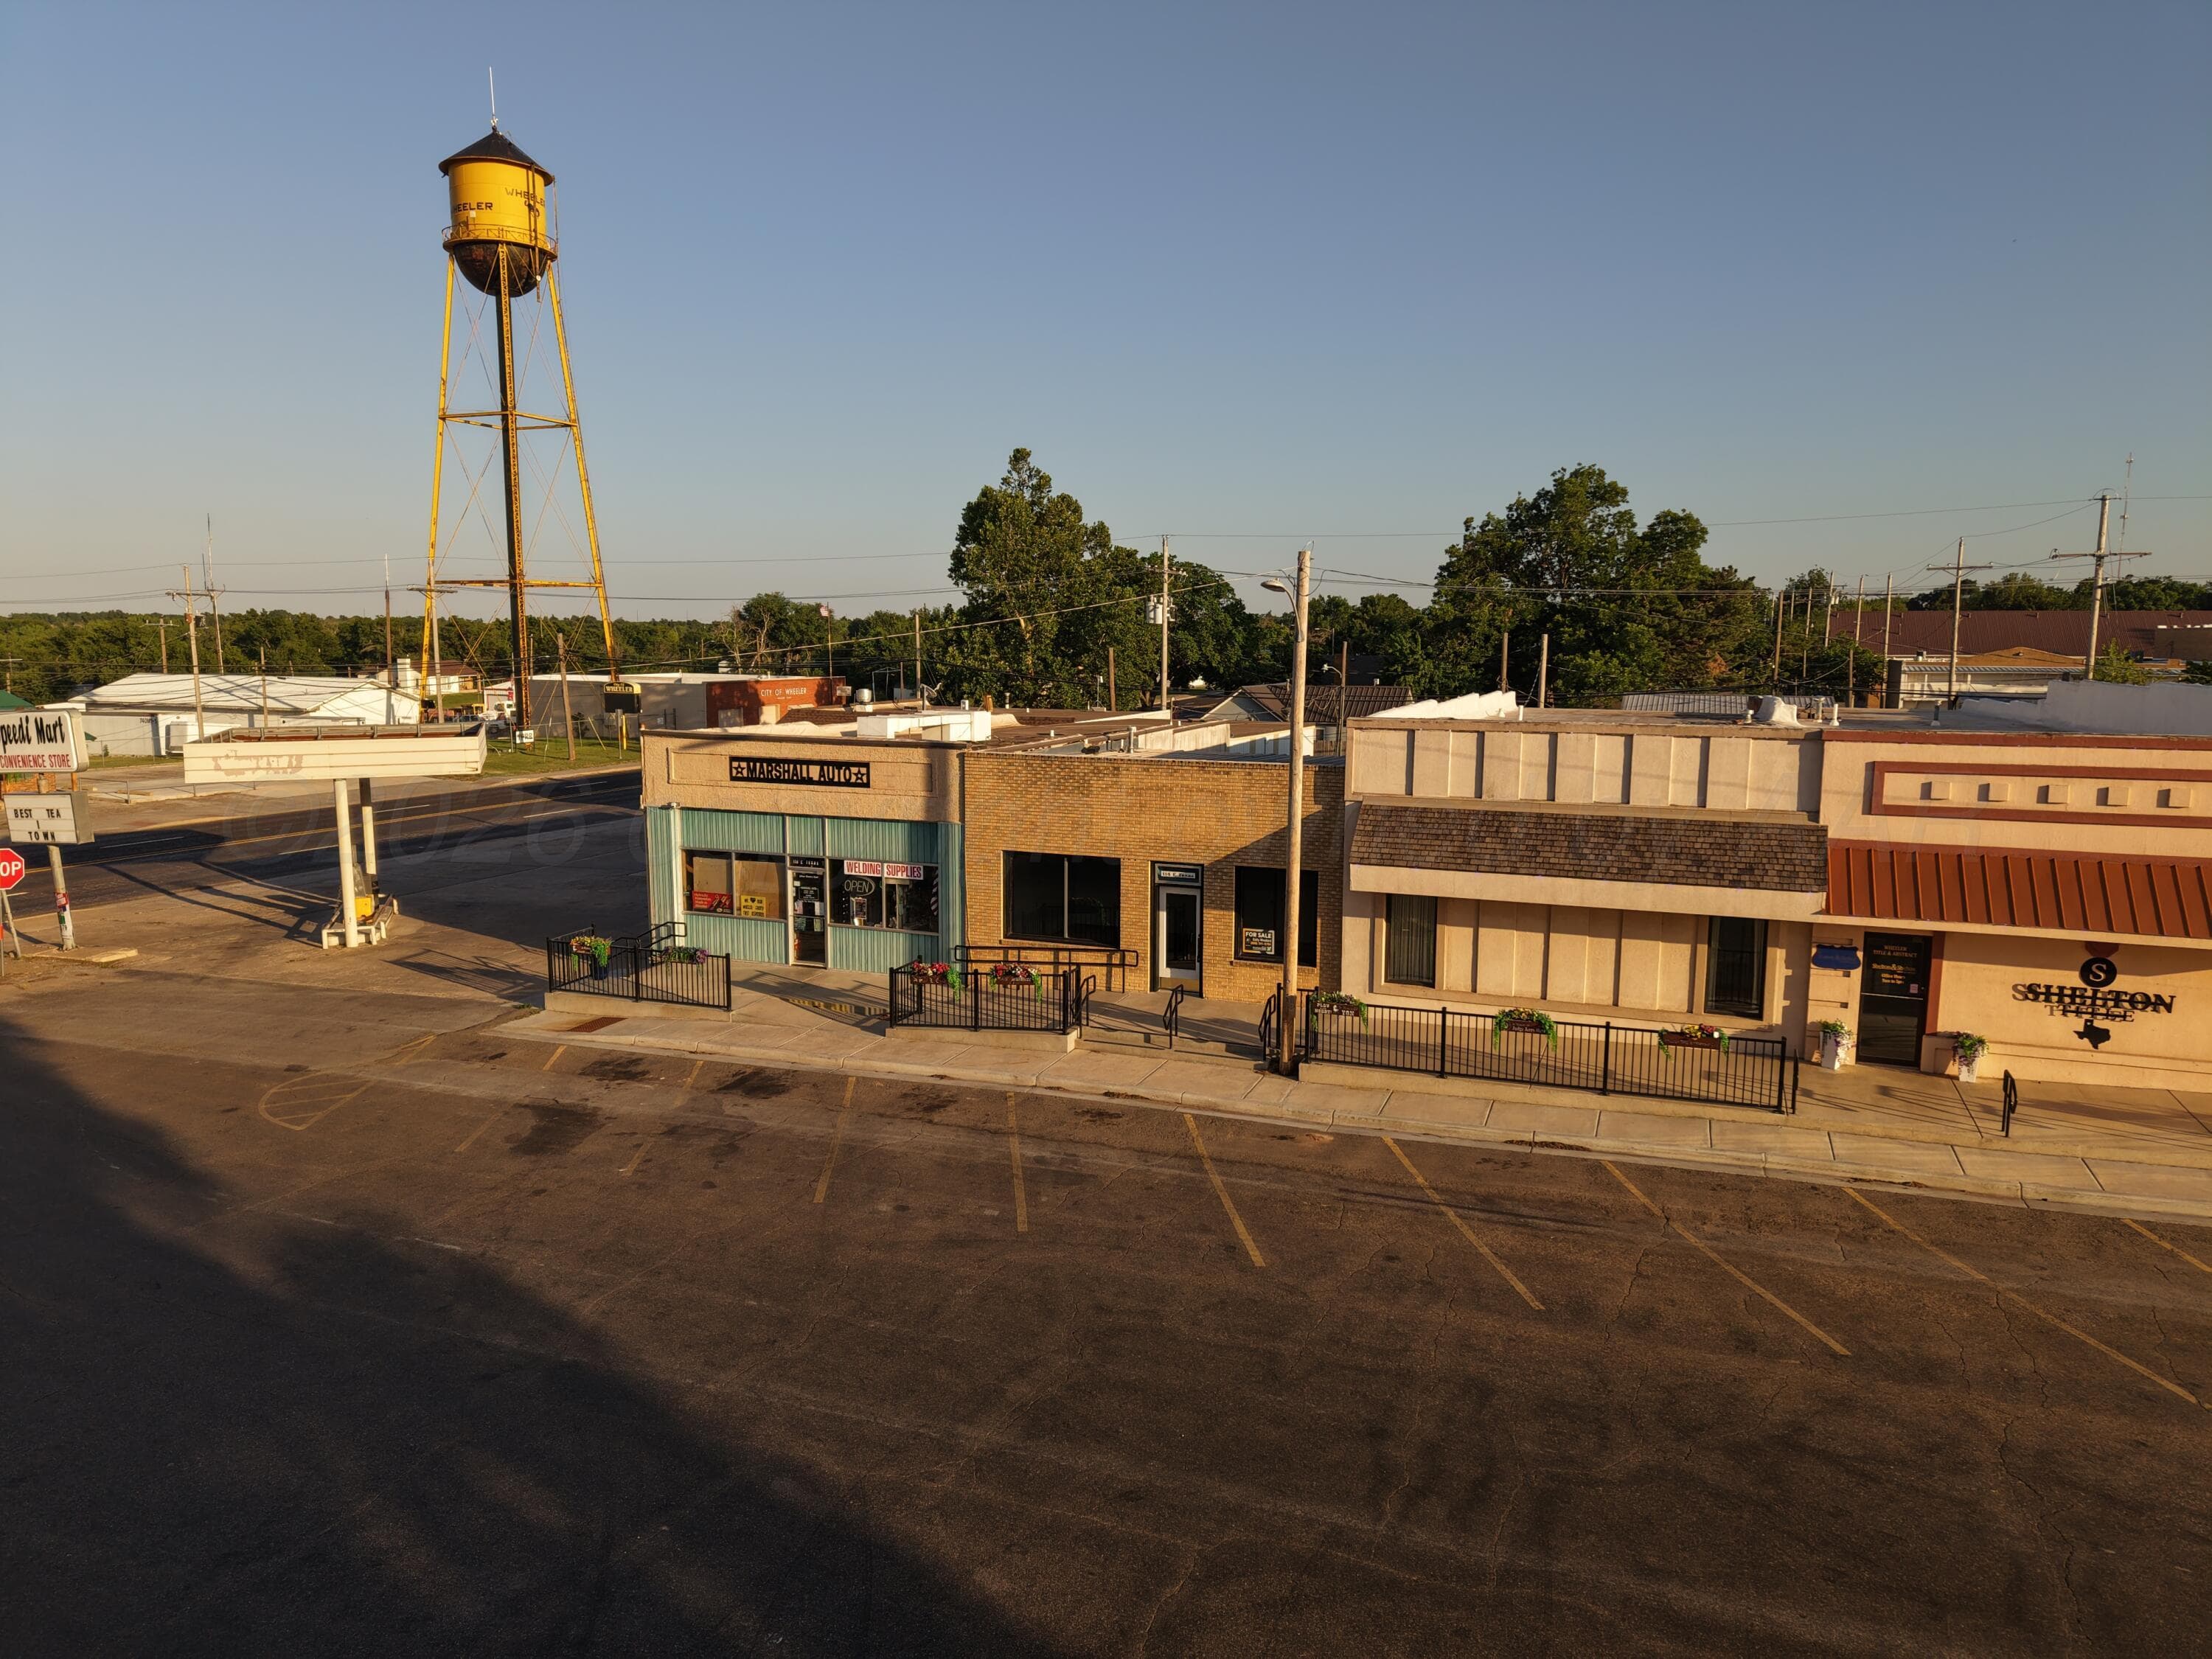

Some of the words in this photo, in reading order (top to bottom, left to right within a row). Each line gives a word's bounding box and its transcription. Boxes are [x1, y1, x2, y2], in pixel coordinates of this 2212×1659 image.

[785, 687, 807, 695] WHEELER
[35, 715, 66, 745] Mart
[0, 754, 46, 769] CONVENIENCE
[49, 754, 72, 768] STORE
[746, 762, 814, 781] MARSHALL
[818, 765, 852, 783] AUTO
[14, 808, 32, 818] BEST
[46, 808, 61, 818] TEA
[36, 820, 40, 830] I
[0, 861, 21, 877] OP
[846, 861, 880, 875] WELDING
[886, 864, 922, 878] SUPPLIES
[844, 880, 869, 893] OPEN
[2089, 963, 2107, 982] S
[2026, 983, 2177, 1014] SHELTON
[2057, 1004, 2135, 1023] TITLE
